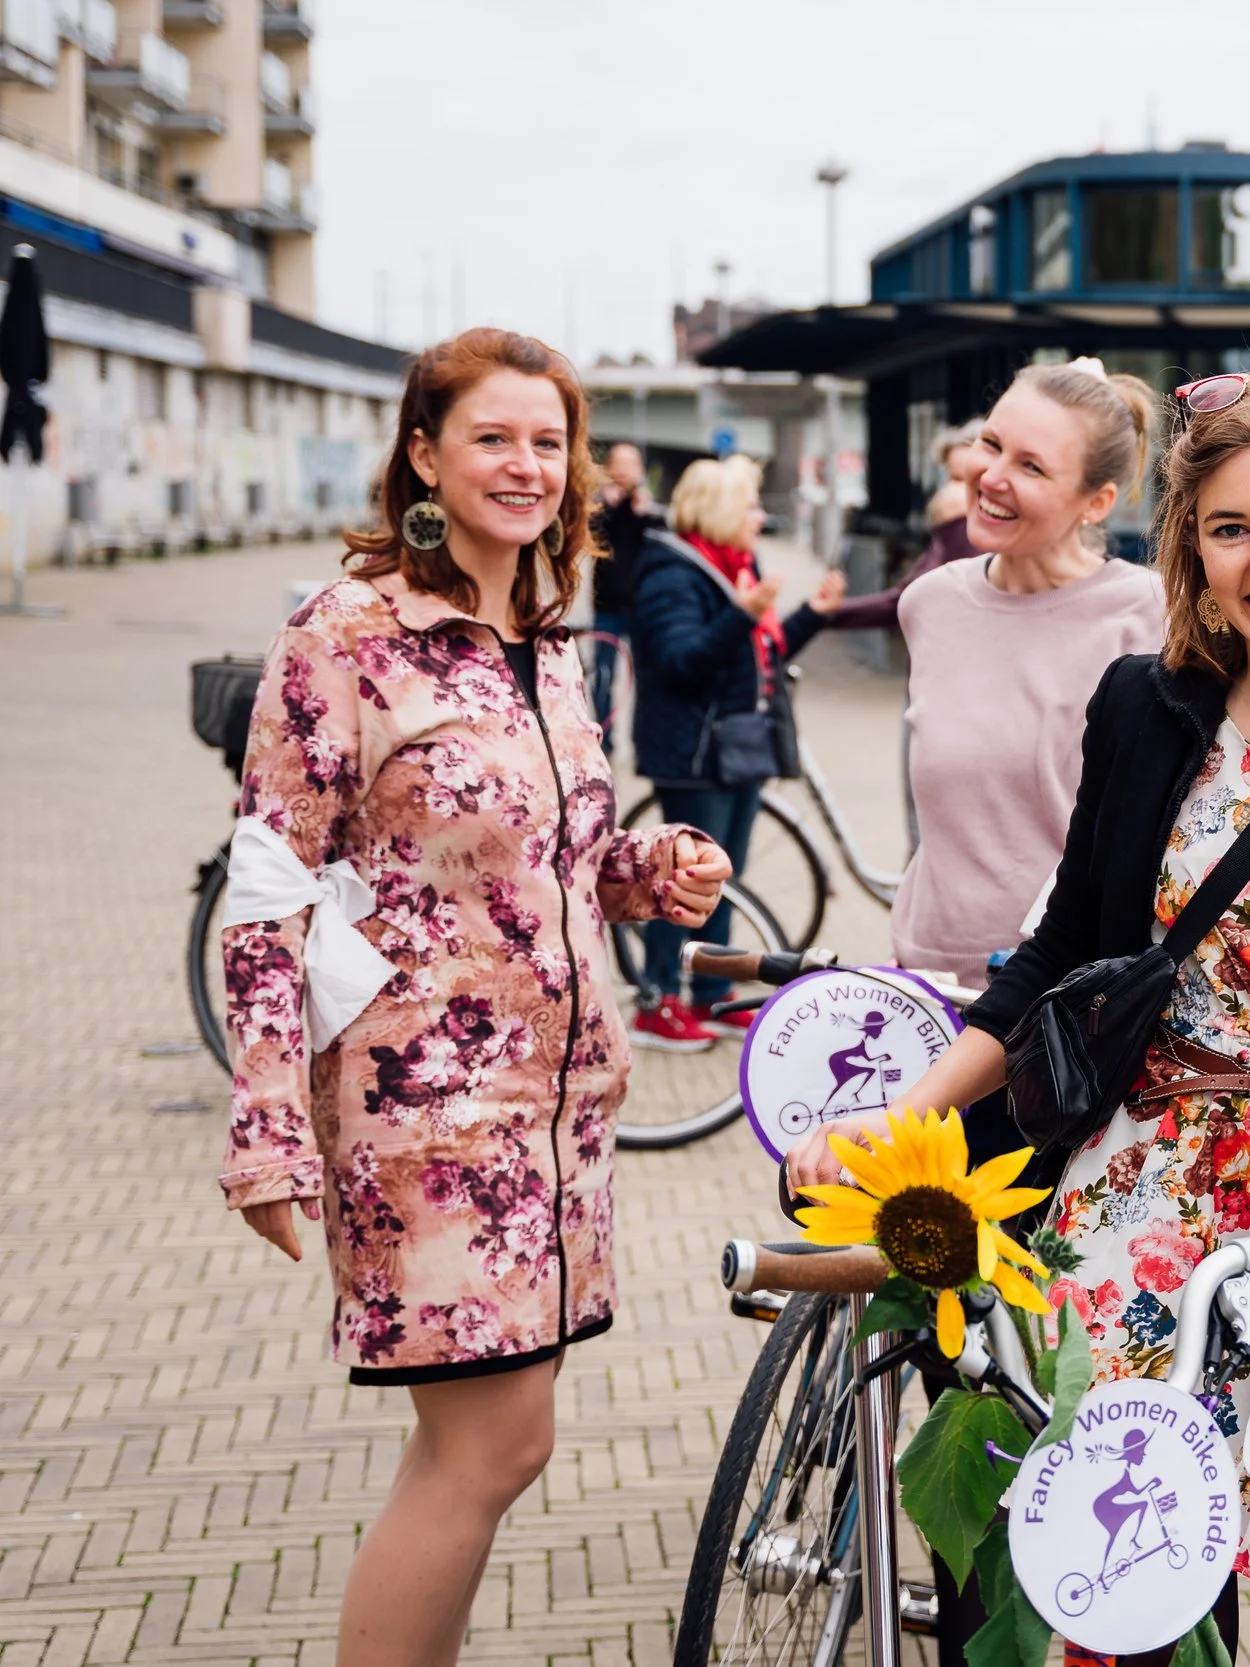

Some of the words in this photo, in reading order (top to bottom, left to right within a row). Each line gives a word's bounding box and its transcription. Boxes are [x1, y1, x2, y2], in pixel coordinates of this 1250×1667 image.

[768, 997, 821, 1057] Fancy
[826, 984, 916, 1021] Women
[1024, 1438, 1075, 1524] Fancy
[1076, 1400, 1178, 1433] Women
[1181, 1420, 1218, 1483] Bike
[1201, 1493, 1229, 1563] Ride
